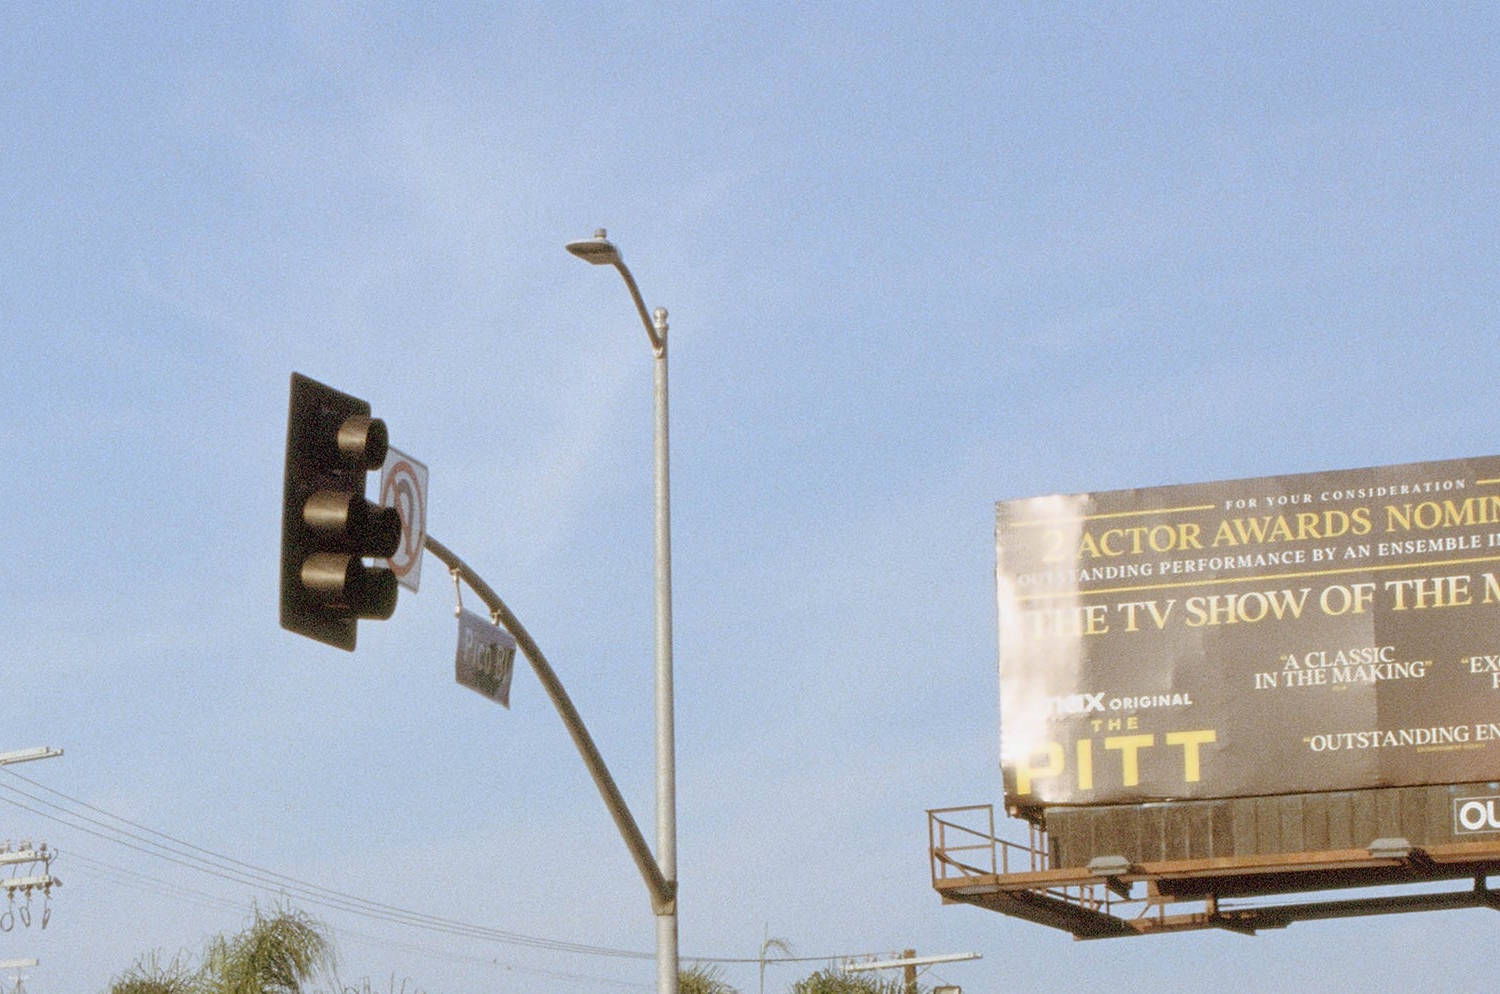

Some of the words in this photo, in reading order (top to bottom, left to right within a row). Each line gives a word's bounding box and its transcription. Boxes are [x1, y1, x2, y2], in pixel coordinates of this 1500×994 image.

[1225, 499, 1257, 511] FOR
[1266, 493, 1312, 507] YOUR
[1320, 479, 1466, 502] CONSIDERATION
[1076, 523, 1205, 561] ACTOR
[1211, 507, 1372, 547] AWARDS
[1385, 495, 1500, 533] NOMI
[1159, 550, 1306, 576] PERFORMANCE
[1312, 546, 1337, 563] BY
[1344, 544, 1371, 560] AN
[1378, 534, 1482, 558] ENSEMBLE
[1024, 603, 1110, 641] THE
[1117, 599, 1177, 633] TV
[1185, 588, 1312, 627] SHOW
[1320, 582, 1376, 616] OF
[1385, 574, 1473, 611] THE
[1304, 645, 1395, 668] CLASSIC
[1254, 671, 1278, 690] IN
[1282, 667, 1327, 687] THE
[1109, 692, 1193, 711] ORIGINAL
[1091, 717, 1139, 733] THE
[1016, 729, 1217, 796] PITT
